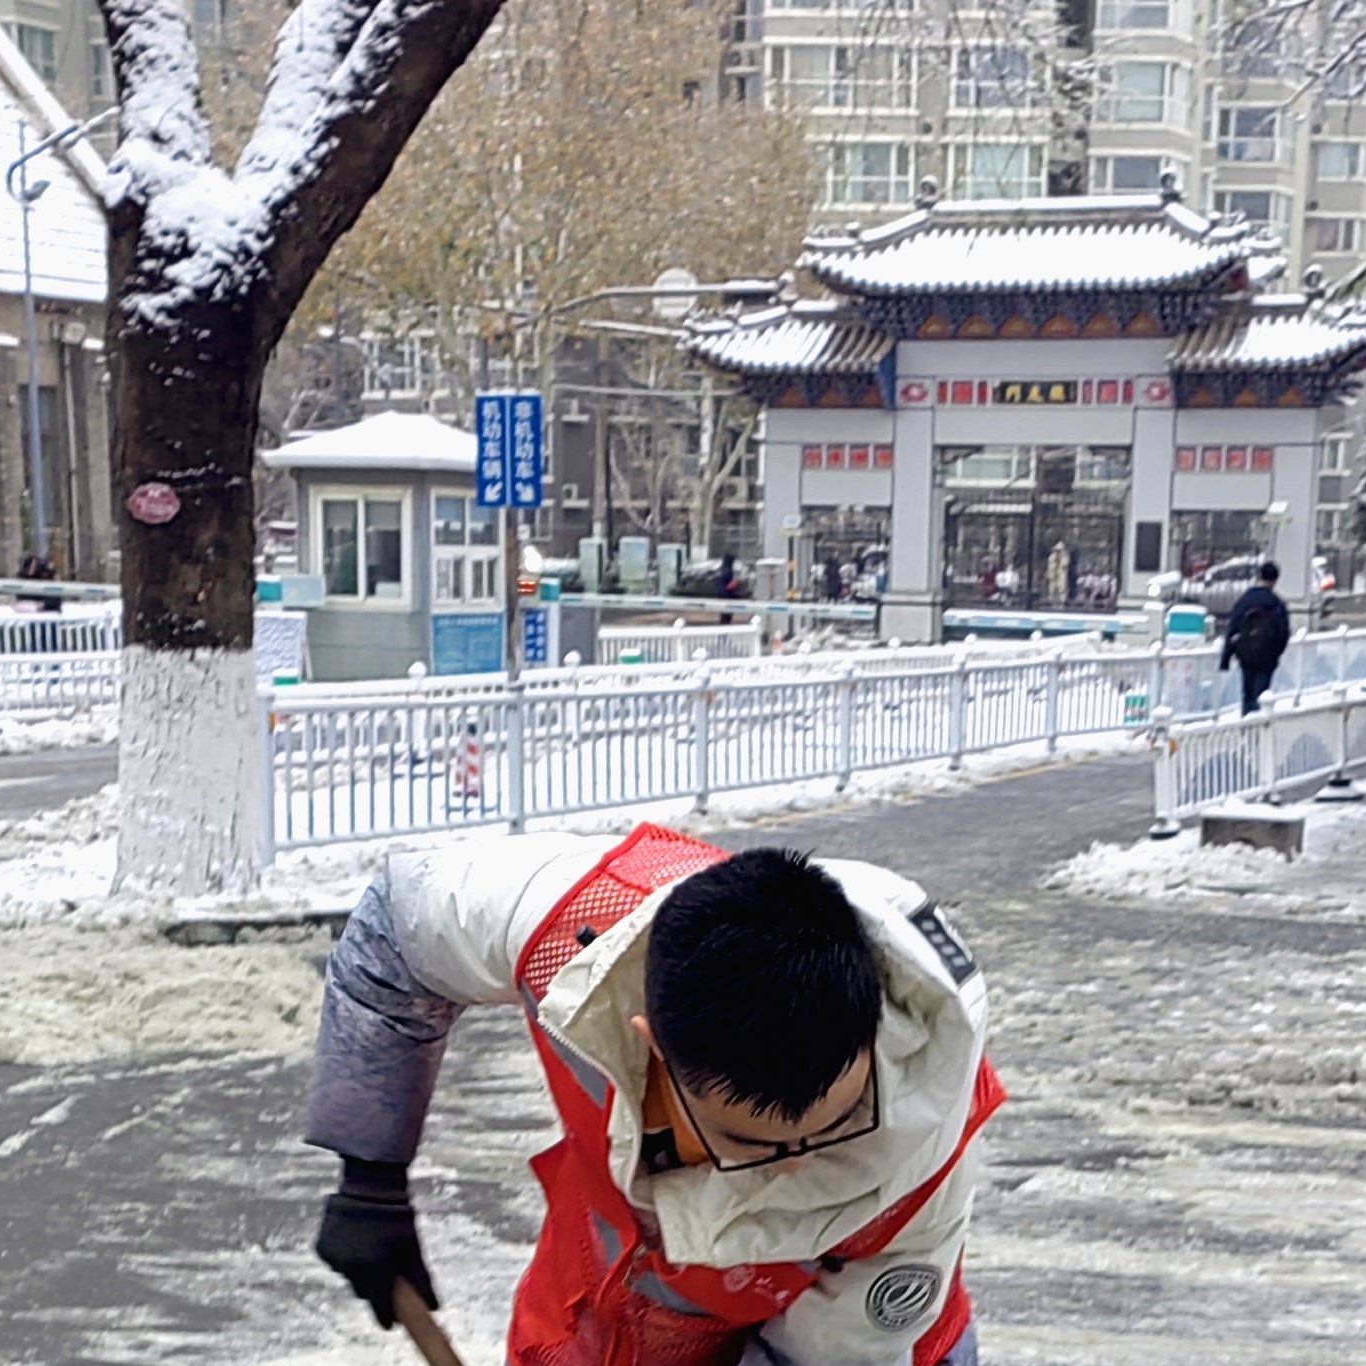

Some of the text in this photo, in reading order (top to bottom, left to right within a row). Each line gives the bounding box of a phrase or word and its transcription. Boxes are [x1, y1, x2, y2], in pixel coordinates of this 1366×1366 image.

[482, 400, 502, 479] 机动车辆
[514, 400, 535, 479] 非机动车
